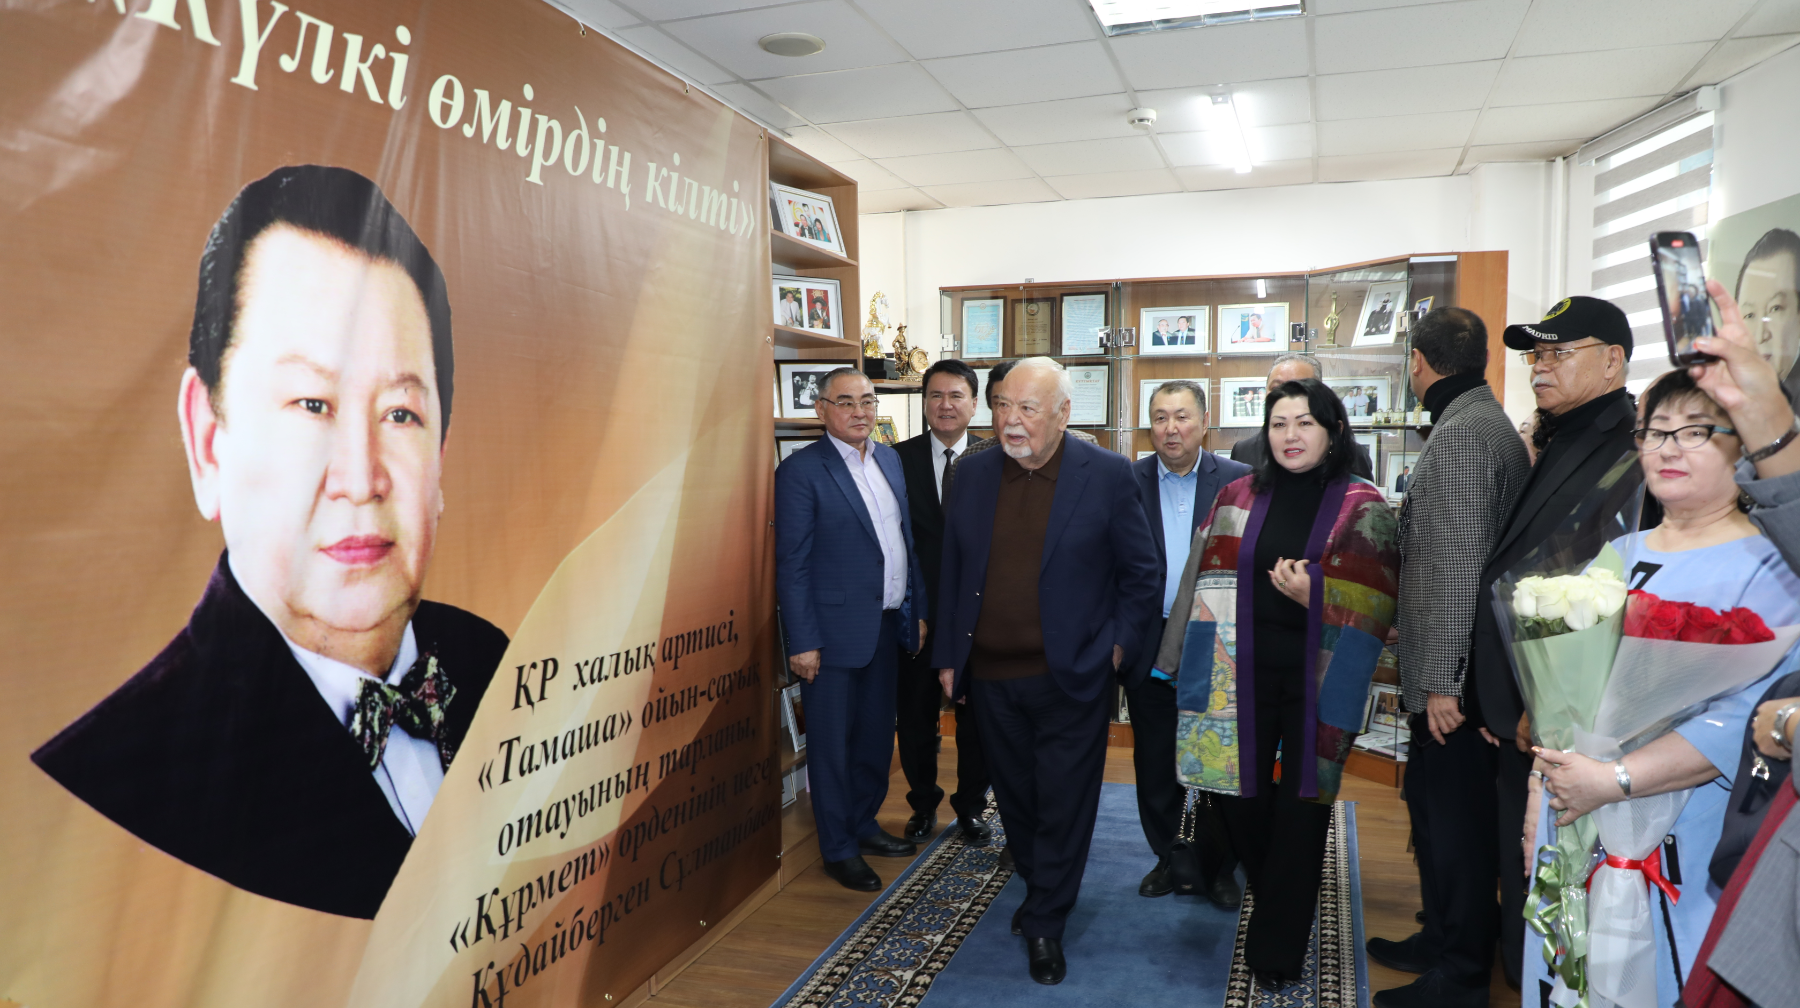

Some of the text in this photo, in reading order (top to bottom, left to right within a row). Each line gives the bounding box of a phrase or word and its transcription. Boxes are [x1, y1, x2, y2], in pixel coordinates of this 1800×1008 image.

[86, 0, 757, 240] үлкі өмірдің кілті»
[1522, 325, 1558, 341] MADRID
[478, 661, 762, 793] «Тамаша» ойын-сауық
[511, 609, 739, 715] ҚР халық артисі,
[497, 714, 757, 857] отауының тарланы,
[659, 800, 776, 891] Сұлтанбаев
[449, 841, 610, 954] «Құрмет»
[618, 774, 728, 863] орденінің
